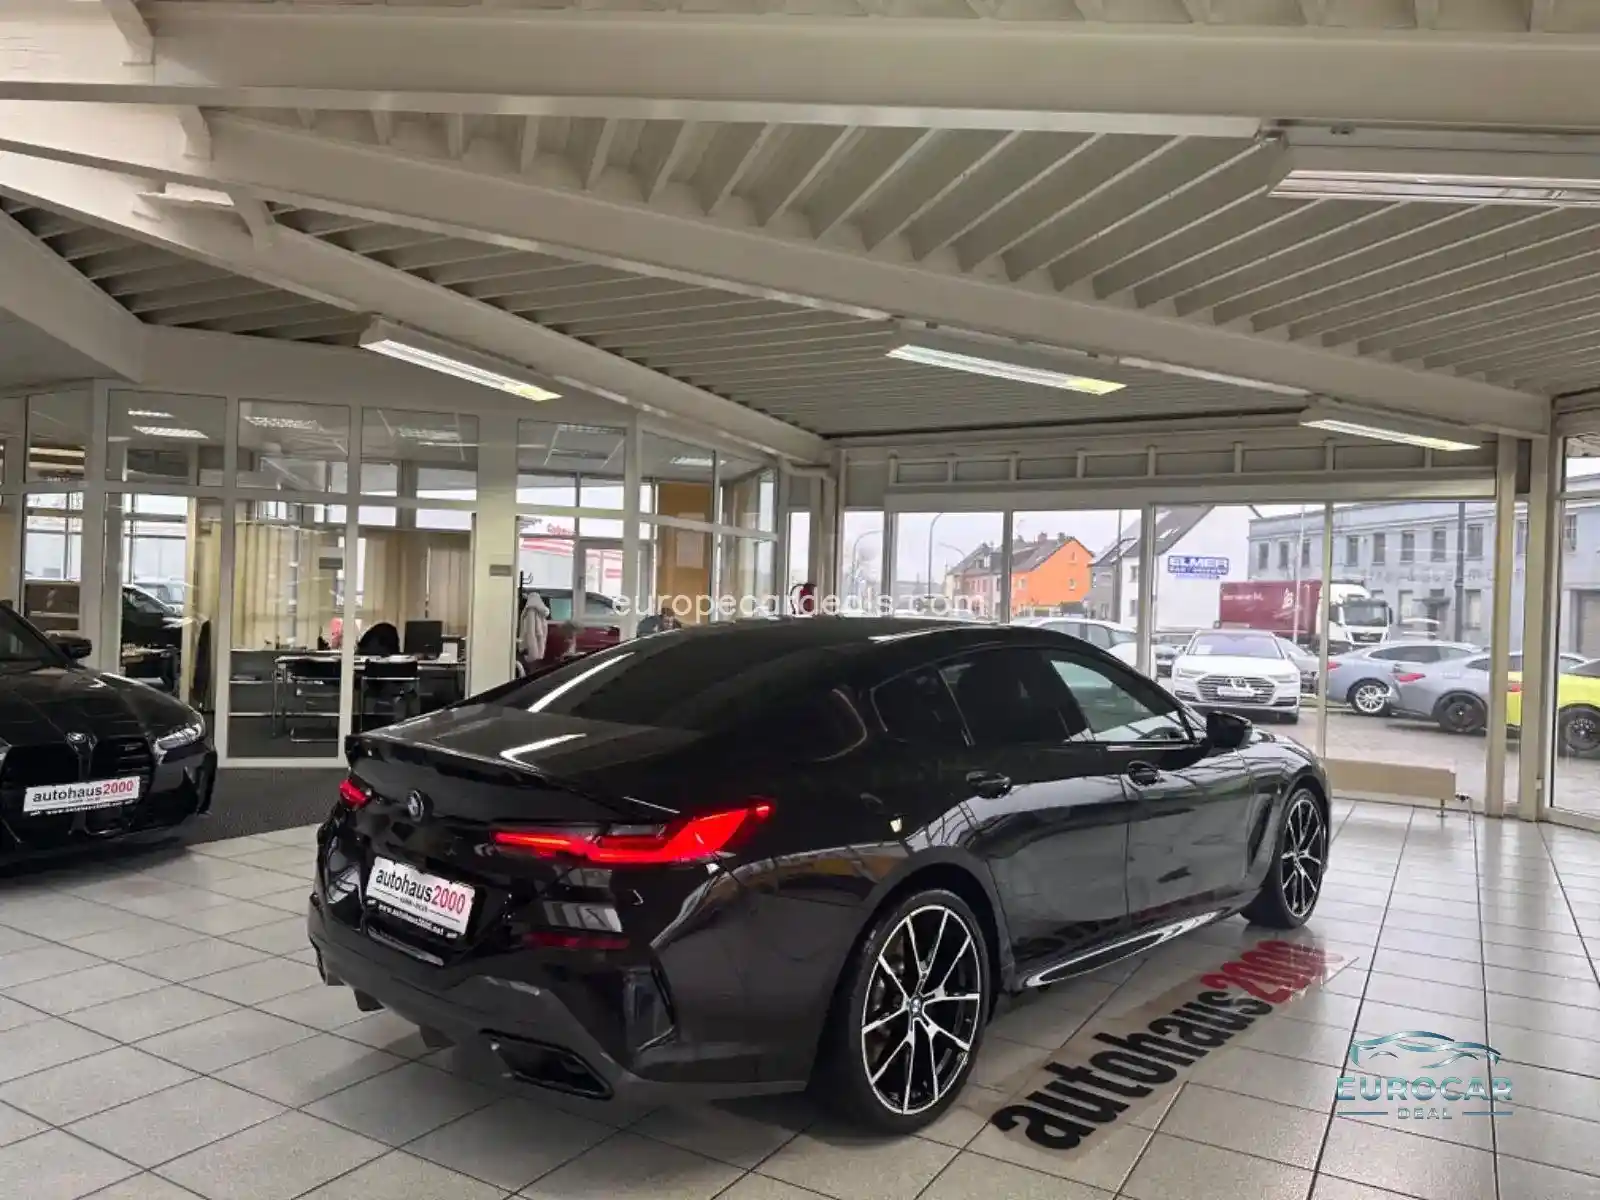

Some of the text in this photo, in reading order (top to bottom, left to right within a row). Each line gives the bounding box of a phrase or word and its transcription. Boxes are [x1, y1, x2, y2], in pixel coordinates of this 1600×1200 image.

[1169, 557, 1228, 568] ELMER
[32, 779, 134, 803] autohaus2000
[375, 869, 466, 915] autohaus2000
